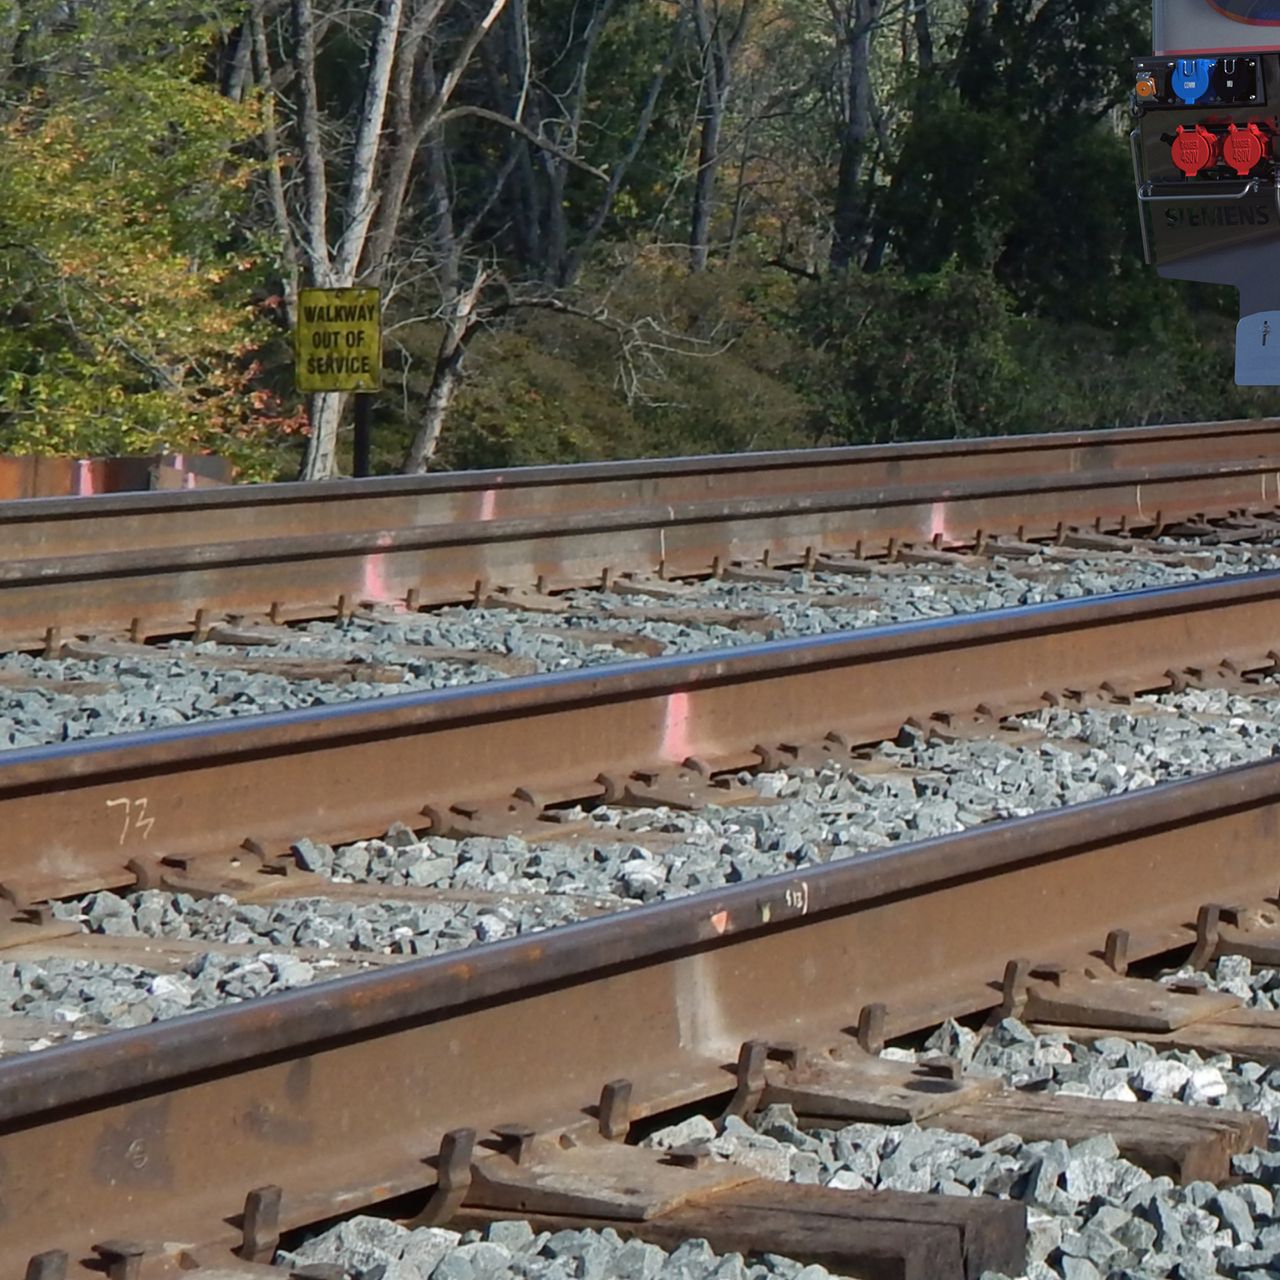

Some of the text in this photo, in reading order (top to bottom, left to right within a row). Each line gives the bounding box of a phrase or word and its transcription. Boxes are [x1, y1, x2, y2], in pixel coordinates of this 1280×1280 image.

[1165, 204, 1270, 228] SIEMENS
[304, 305, 375, 321] WALKWAY
[312, 331, 365, 348] OUT OF
[307, 356, 370, 375] SERVICE
